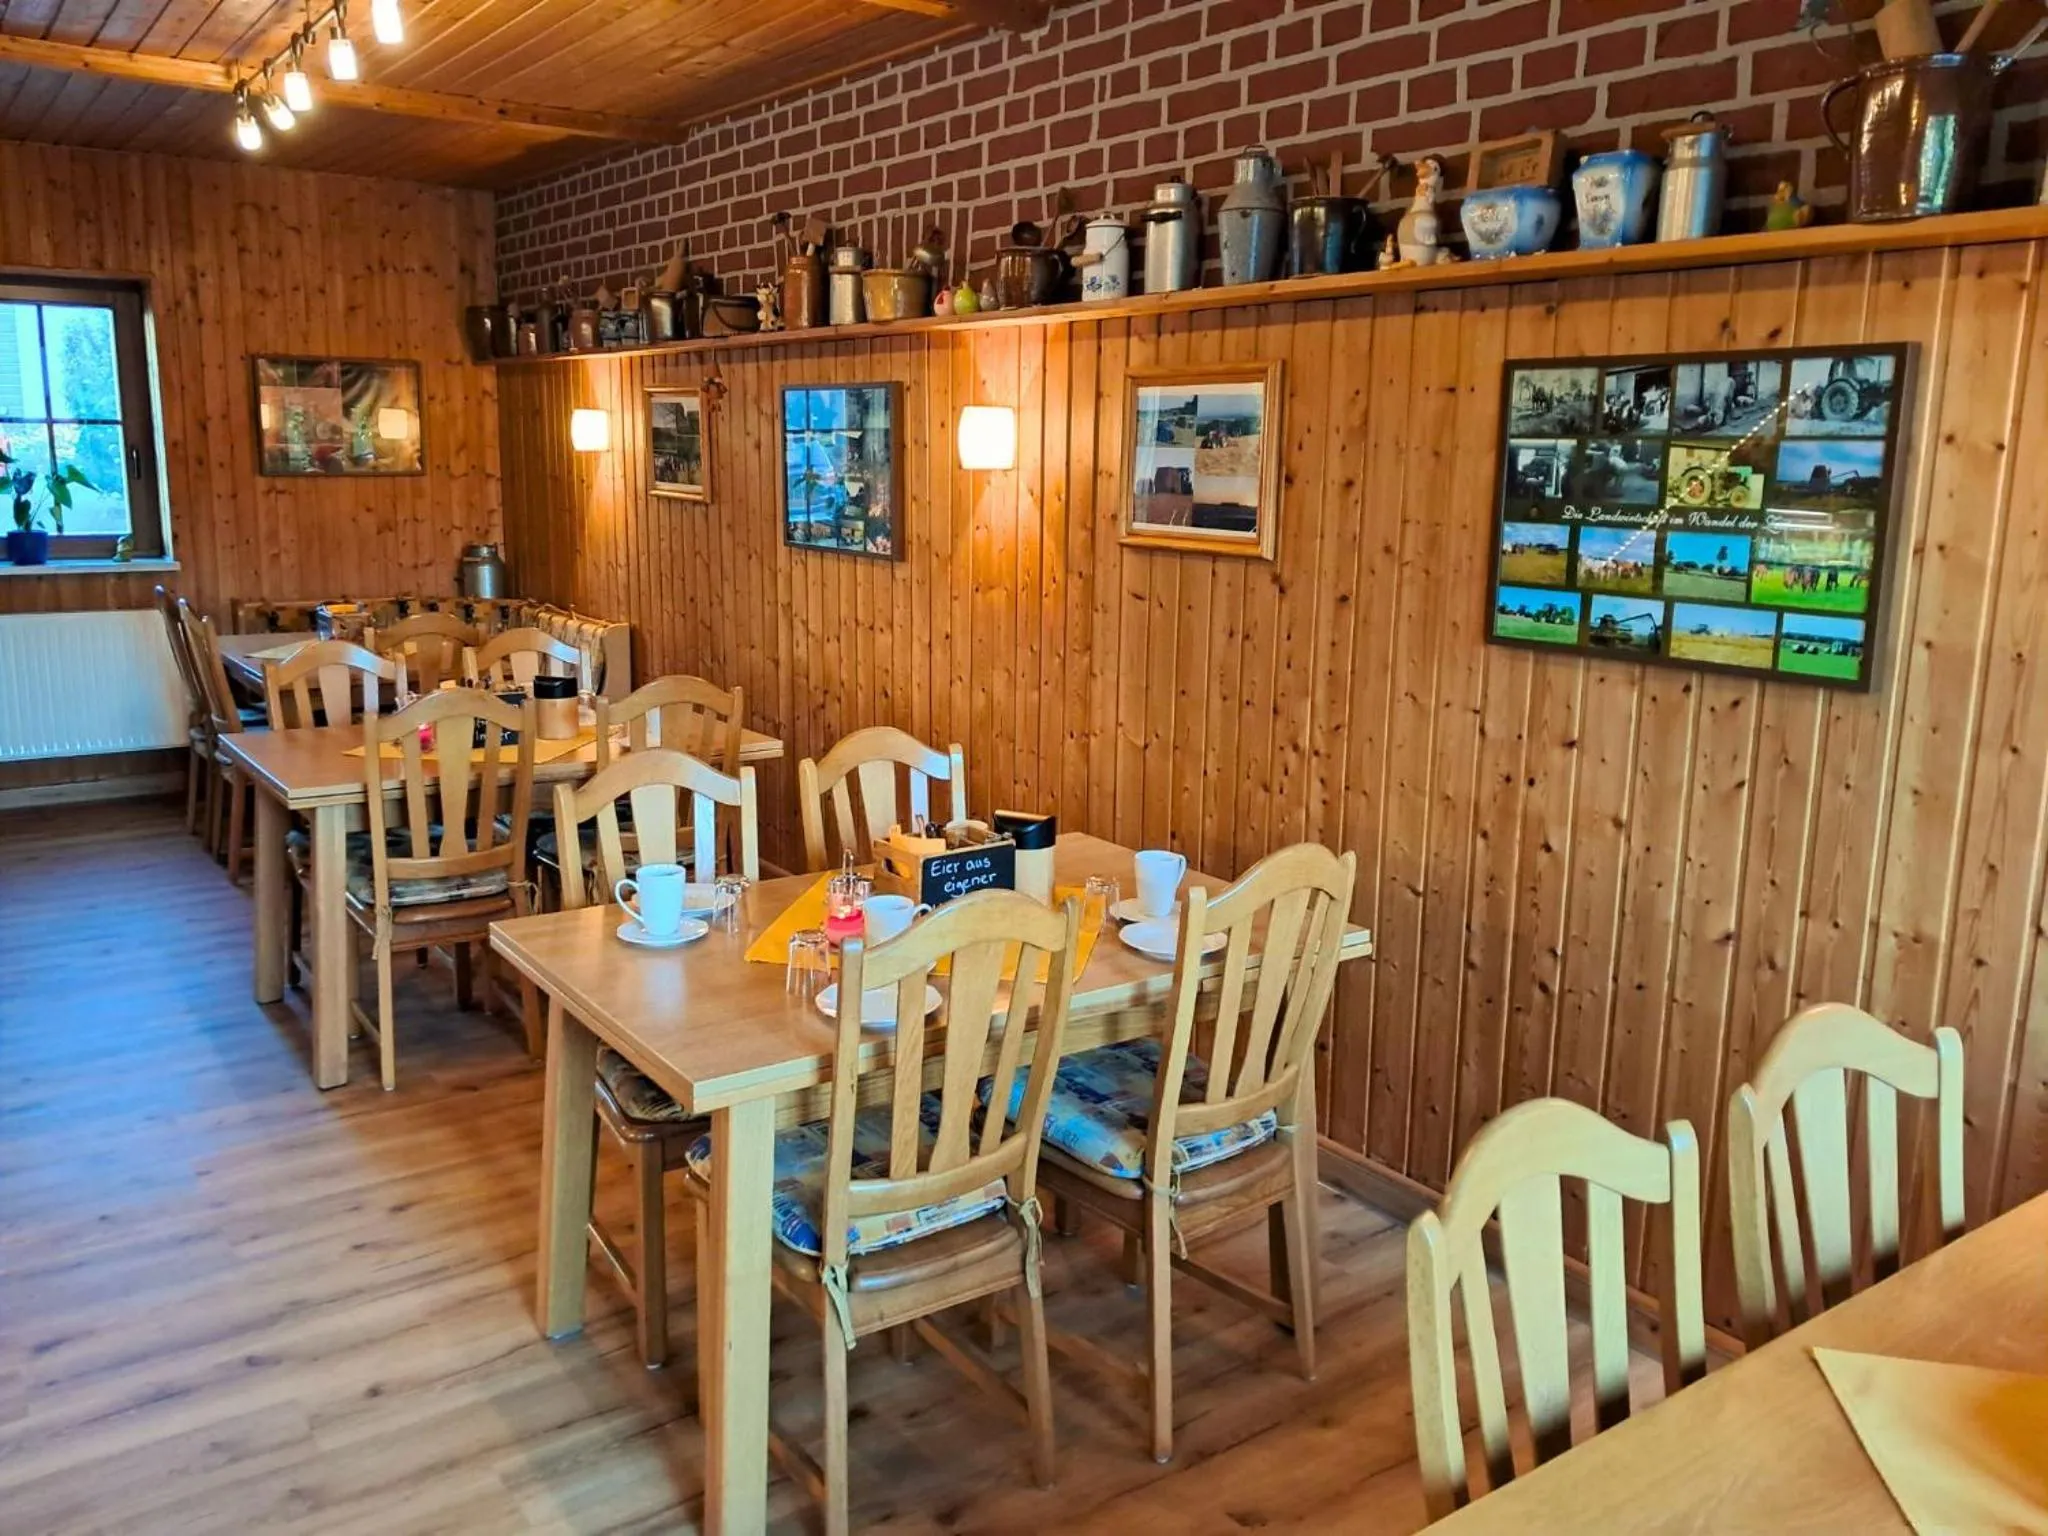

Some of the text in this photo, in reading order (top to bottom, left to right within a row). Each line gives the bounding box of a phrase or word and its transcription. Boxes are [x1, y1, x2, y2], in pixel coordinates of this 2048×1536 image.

[1561, 505, 1583, 519] Die
[1586, 506, 1668, 528] Landwirtschaft
[1669, 516, 1684, 525] im
[1688, 511, 1739, 528] Wandel
[1738, 515, 1758, 529] der
[930, 857, 991, 877] Eier aus
[944, 873, 997, 898] eigener
